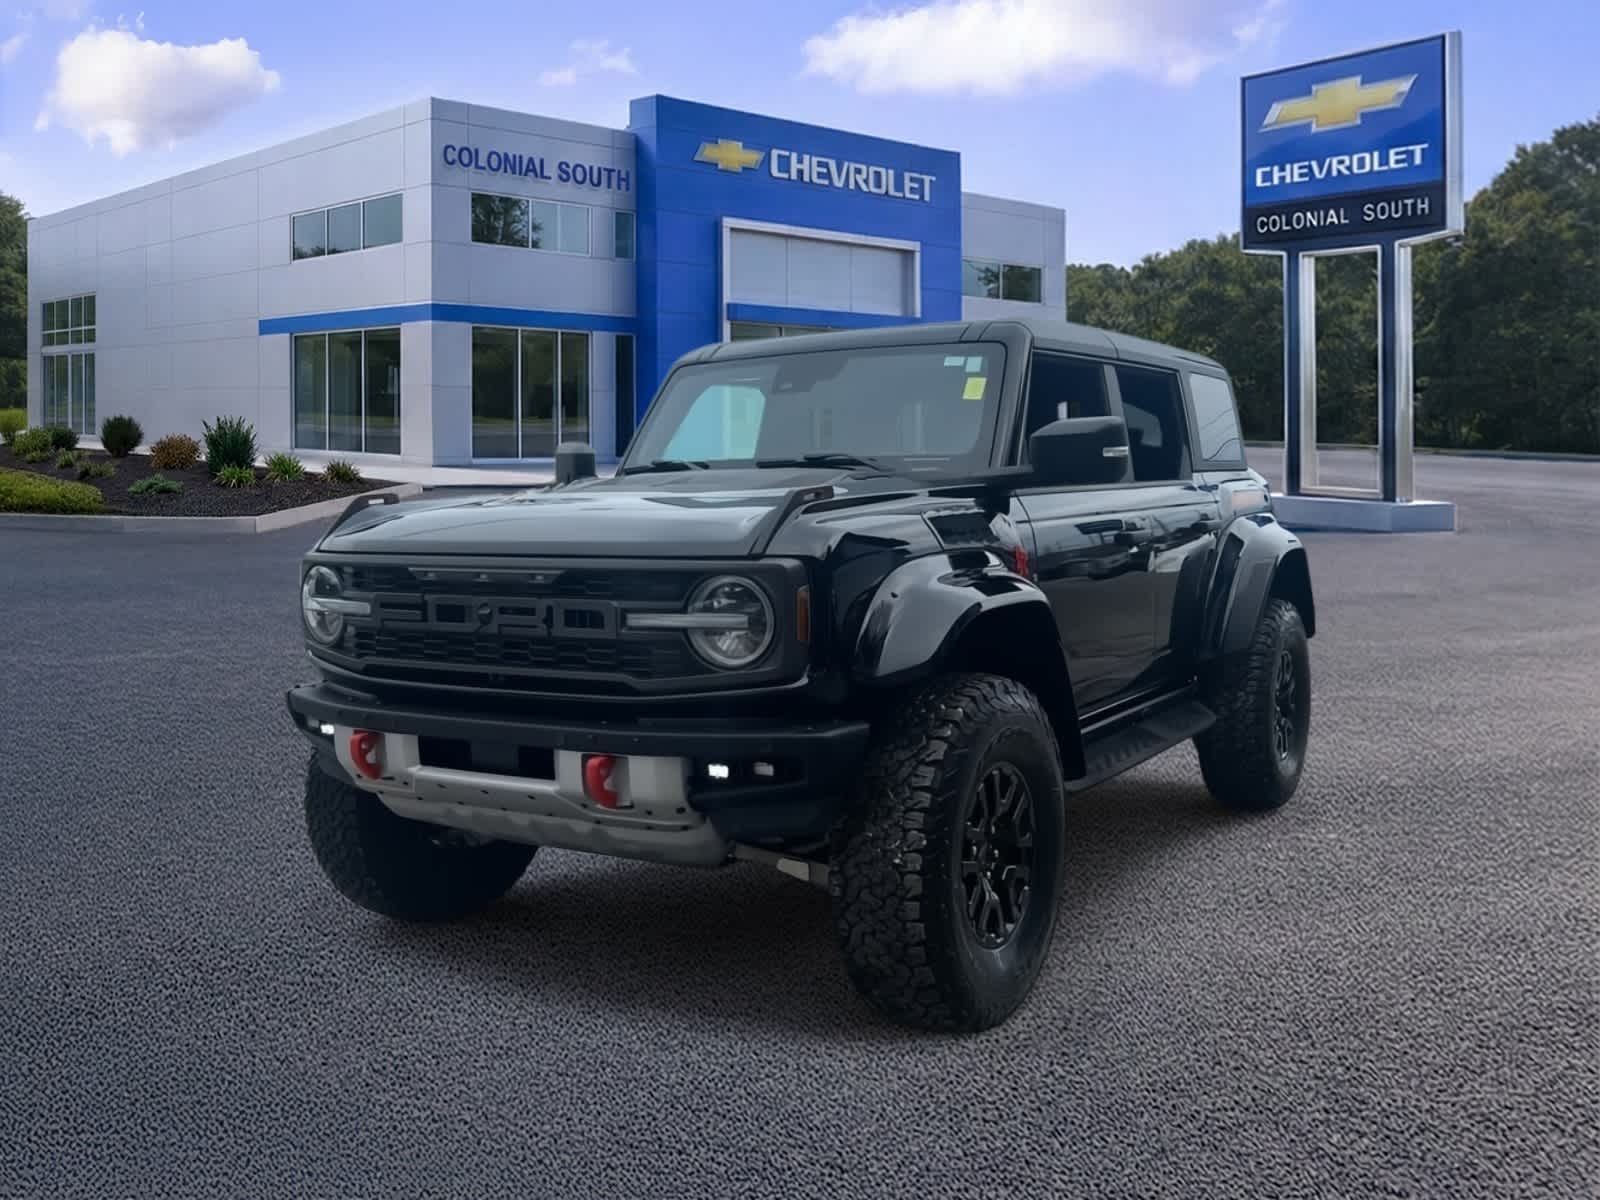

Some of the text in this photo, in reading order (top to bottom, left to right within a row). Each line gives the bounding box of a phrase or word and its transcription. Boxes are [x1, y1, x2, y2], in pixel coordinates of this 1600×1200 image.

[443, 144, 631, 192] COLONIAL SOUTH
[770, 148, 936, 203] CHEVROLET
[1255, 143, 1429, 188] CHEVROLET
[1256, 197, 1430, 233] COLONIAL SOUTH
